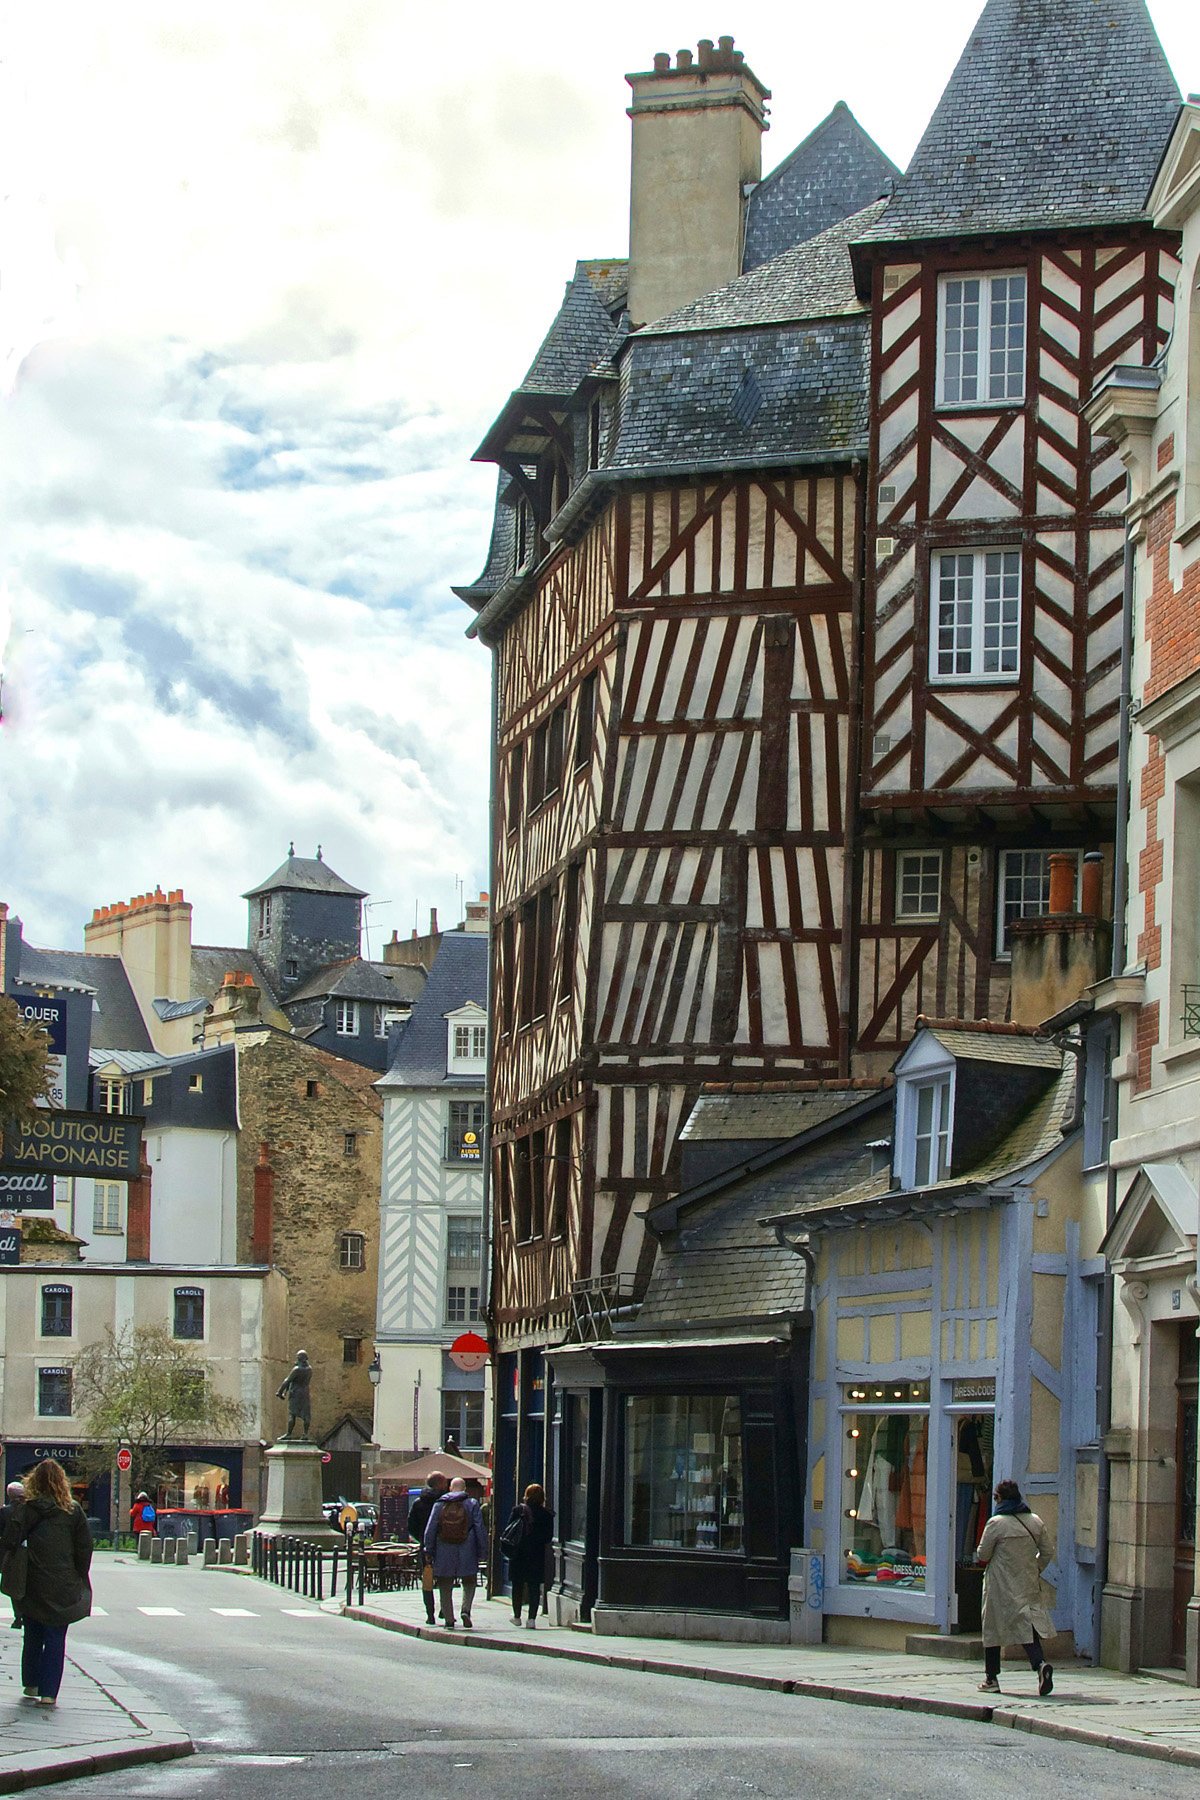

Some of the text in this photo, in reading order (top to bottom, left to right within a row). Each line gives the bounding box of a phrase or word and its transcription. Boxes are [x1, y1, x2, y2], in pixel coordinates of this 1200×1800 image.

[18, 1005, 59, 1021] LOUER
[20, 1120, 126, 1145] BOUTIQUE
[15, 1141, 130, 1169] JAPONAISE
[34, 1448, 81, 1458] CAROLL
